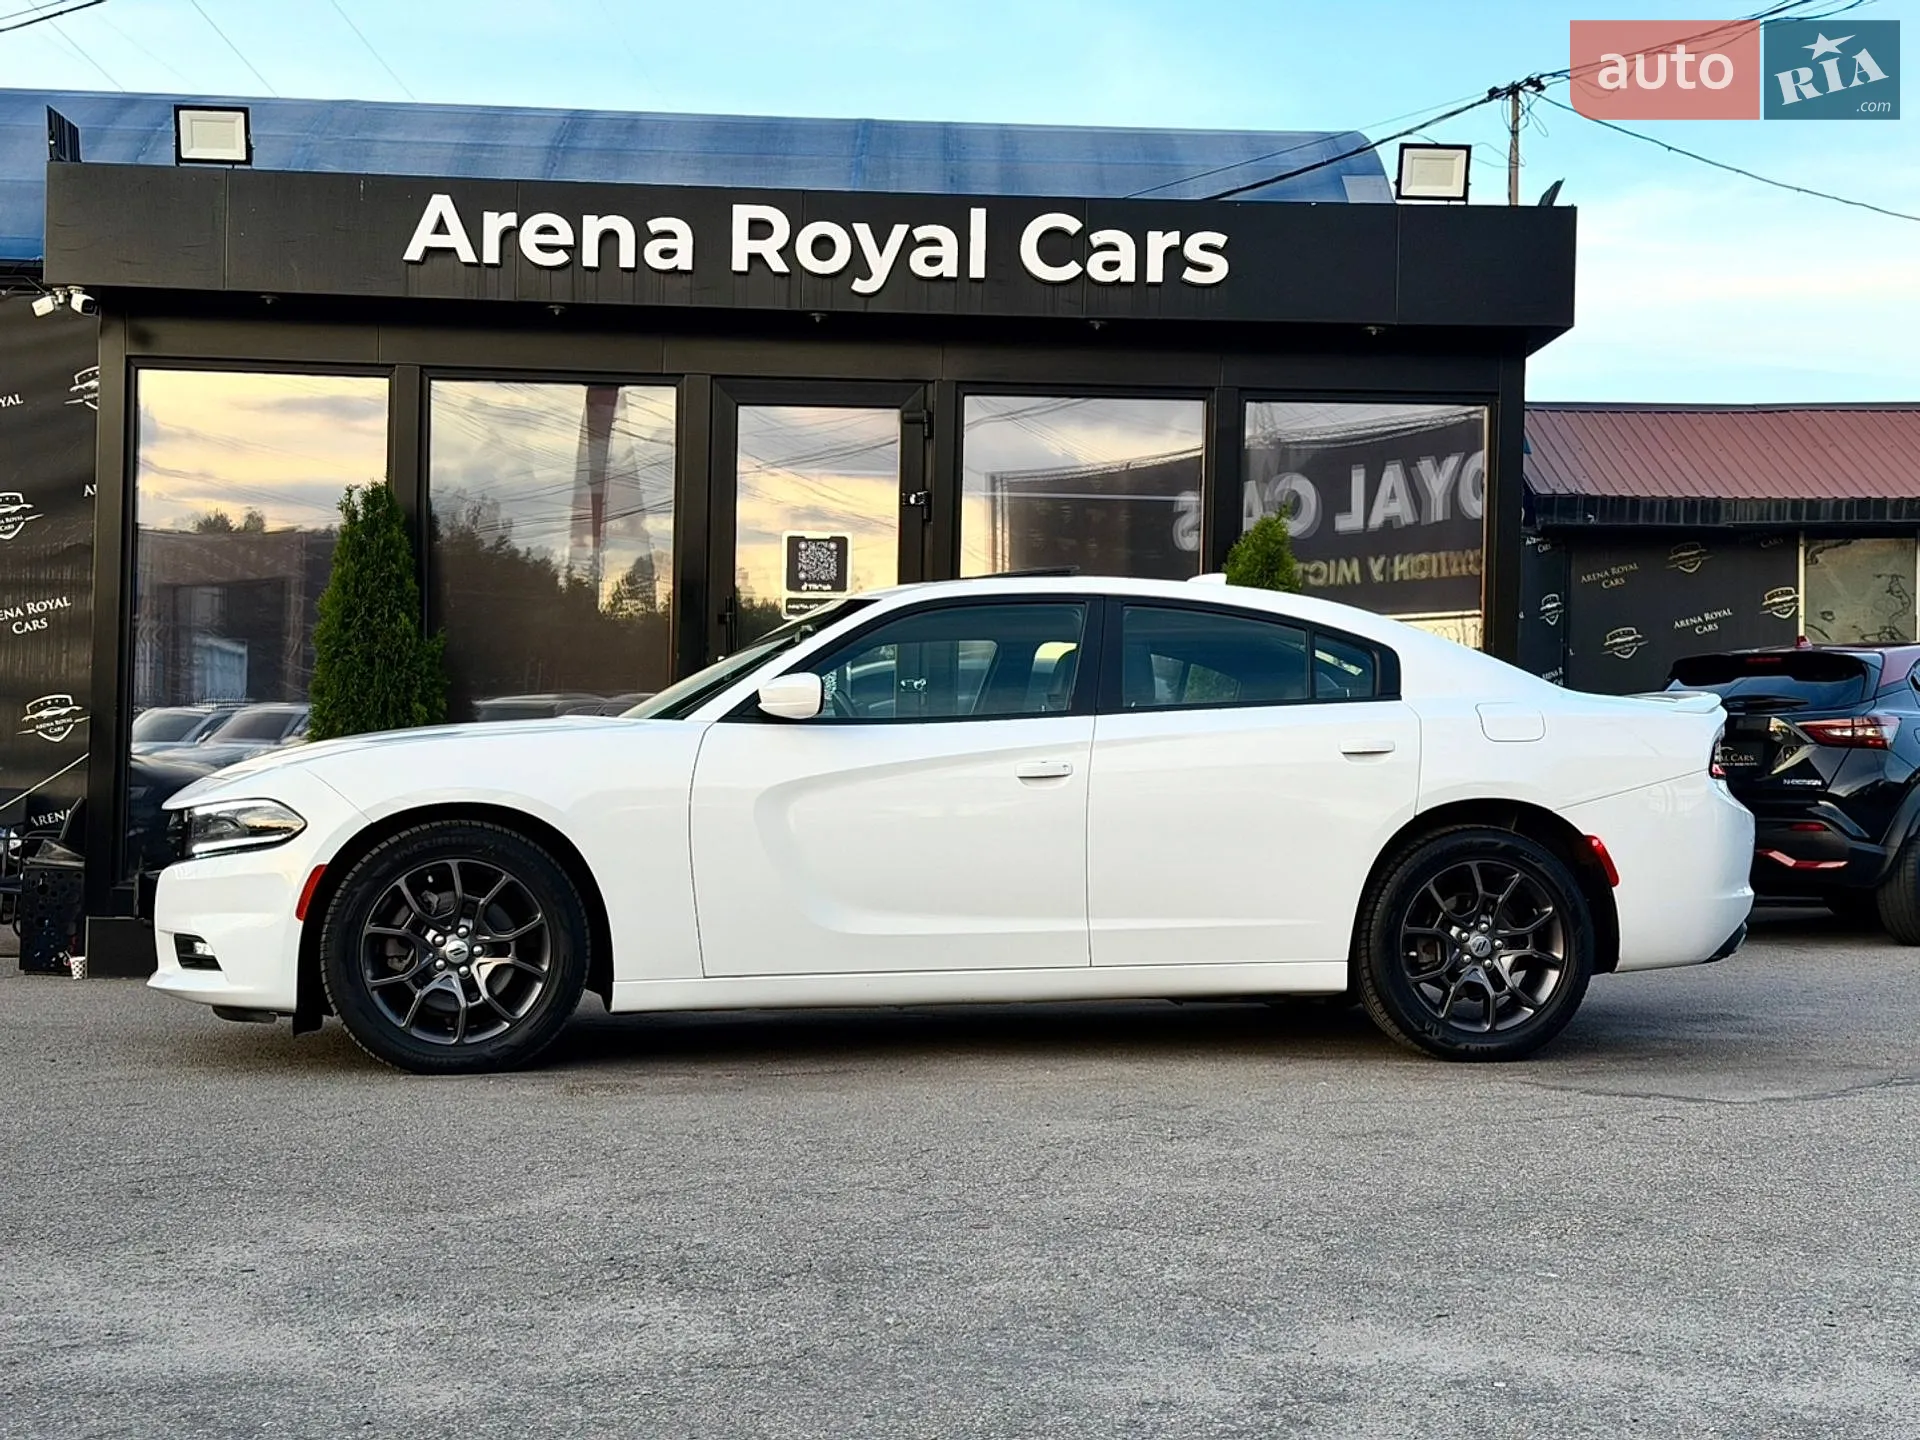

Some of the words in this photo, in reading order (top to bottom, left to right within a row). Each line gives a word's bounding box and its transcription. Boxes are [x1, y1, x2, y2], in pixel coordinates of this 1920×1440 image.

[402, 193, 694, 272] Arena
[730, 203, 987, 295] Royal
[1019, 212, 1230, 287] Cars
[1580, 569, 1610, 584] ARENA
[1610, 561, 1640, 576] ROYAL
[1601, 577, 1626, 589] CARS
[26, 596, 72, 614] ROYAL
[12, 617, 48, 634] CARS
[1673, 612, 1705, 629] ARENA
[1704, 607, 1733, 621] ROYAL
[1694, 623, 1719, 635] CARS
